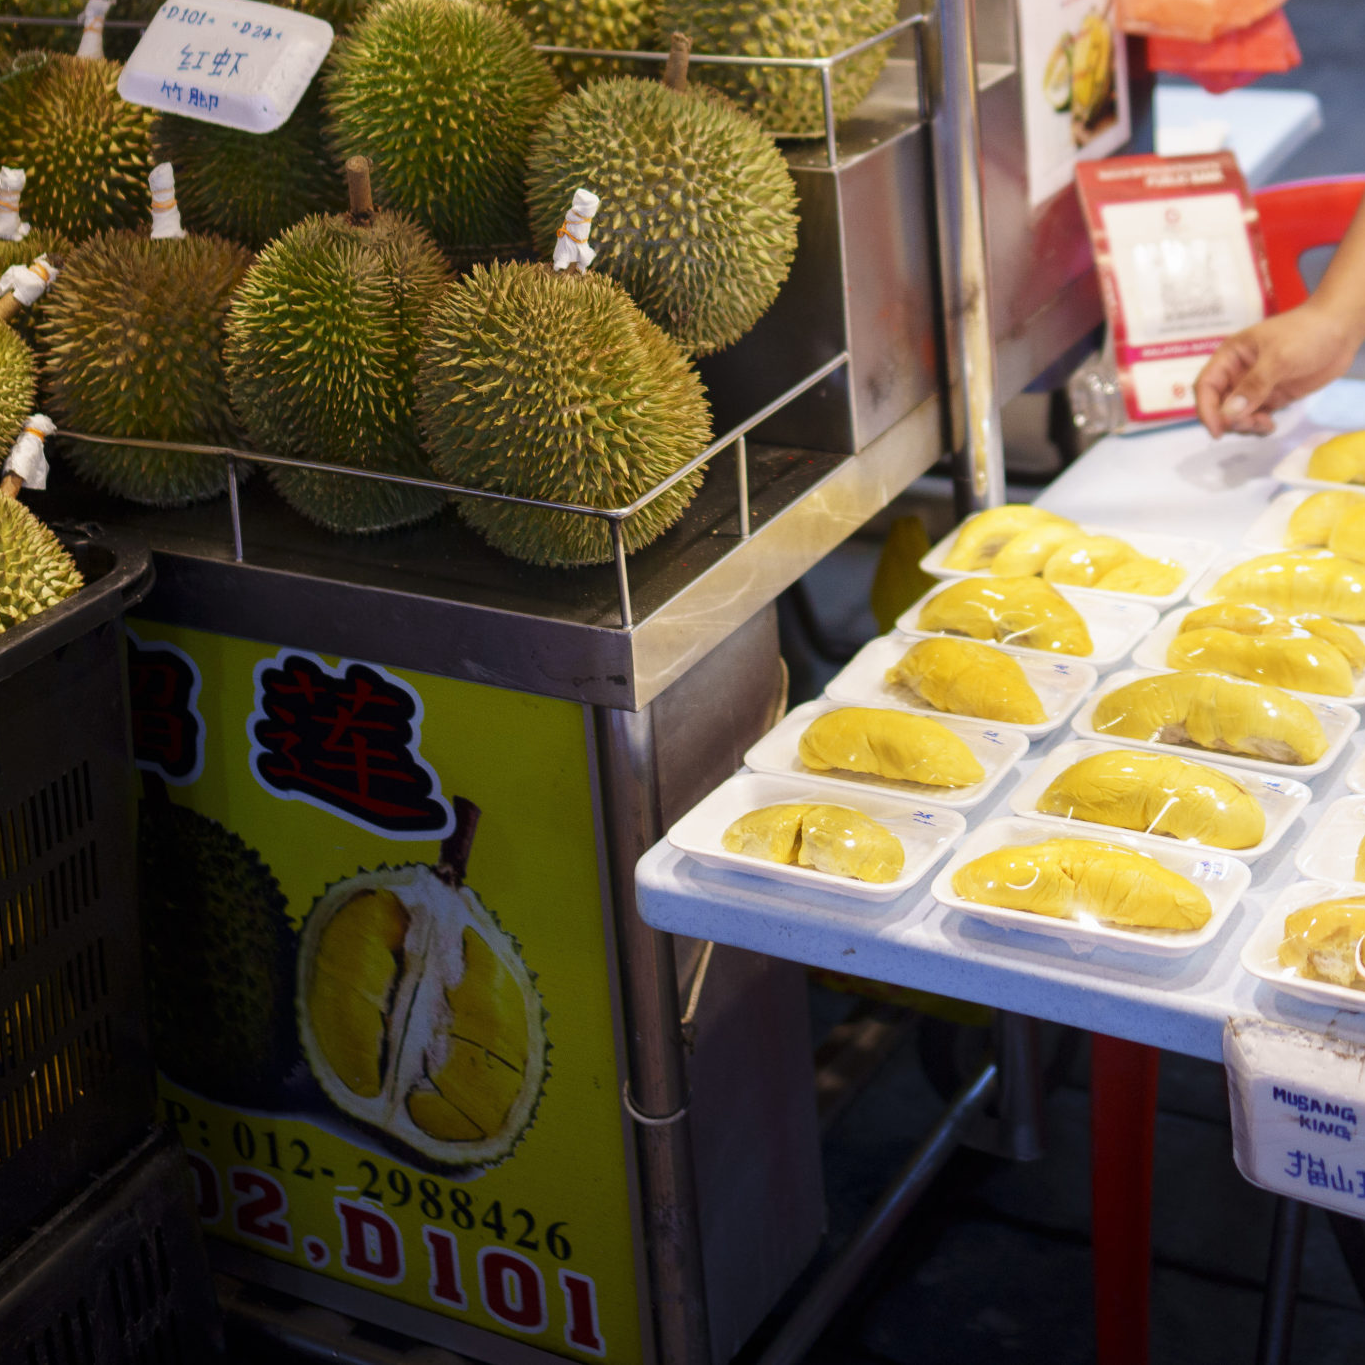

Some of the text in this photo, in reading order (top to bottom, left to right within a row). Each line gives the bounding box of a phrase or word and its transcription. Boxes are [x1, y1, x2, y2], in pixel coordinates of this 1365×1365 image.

[1272, 1086, 1358, 1125] MUSANG
[1299, 1114, 1352, 1142] KING
[232, 1121, 335, 1180] 012-
[357, 1160, 573, 1261] 2988426
